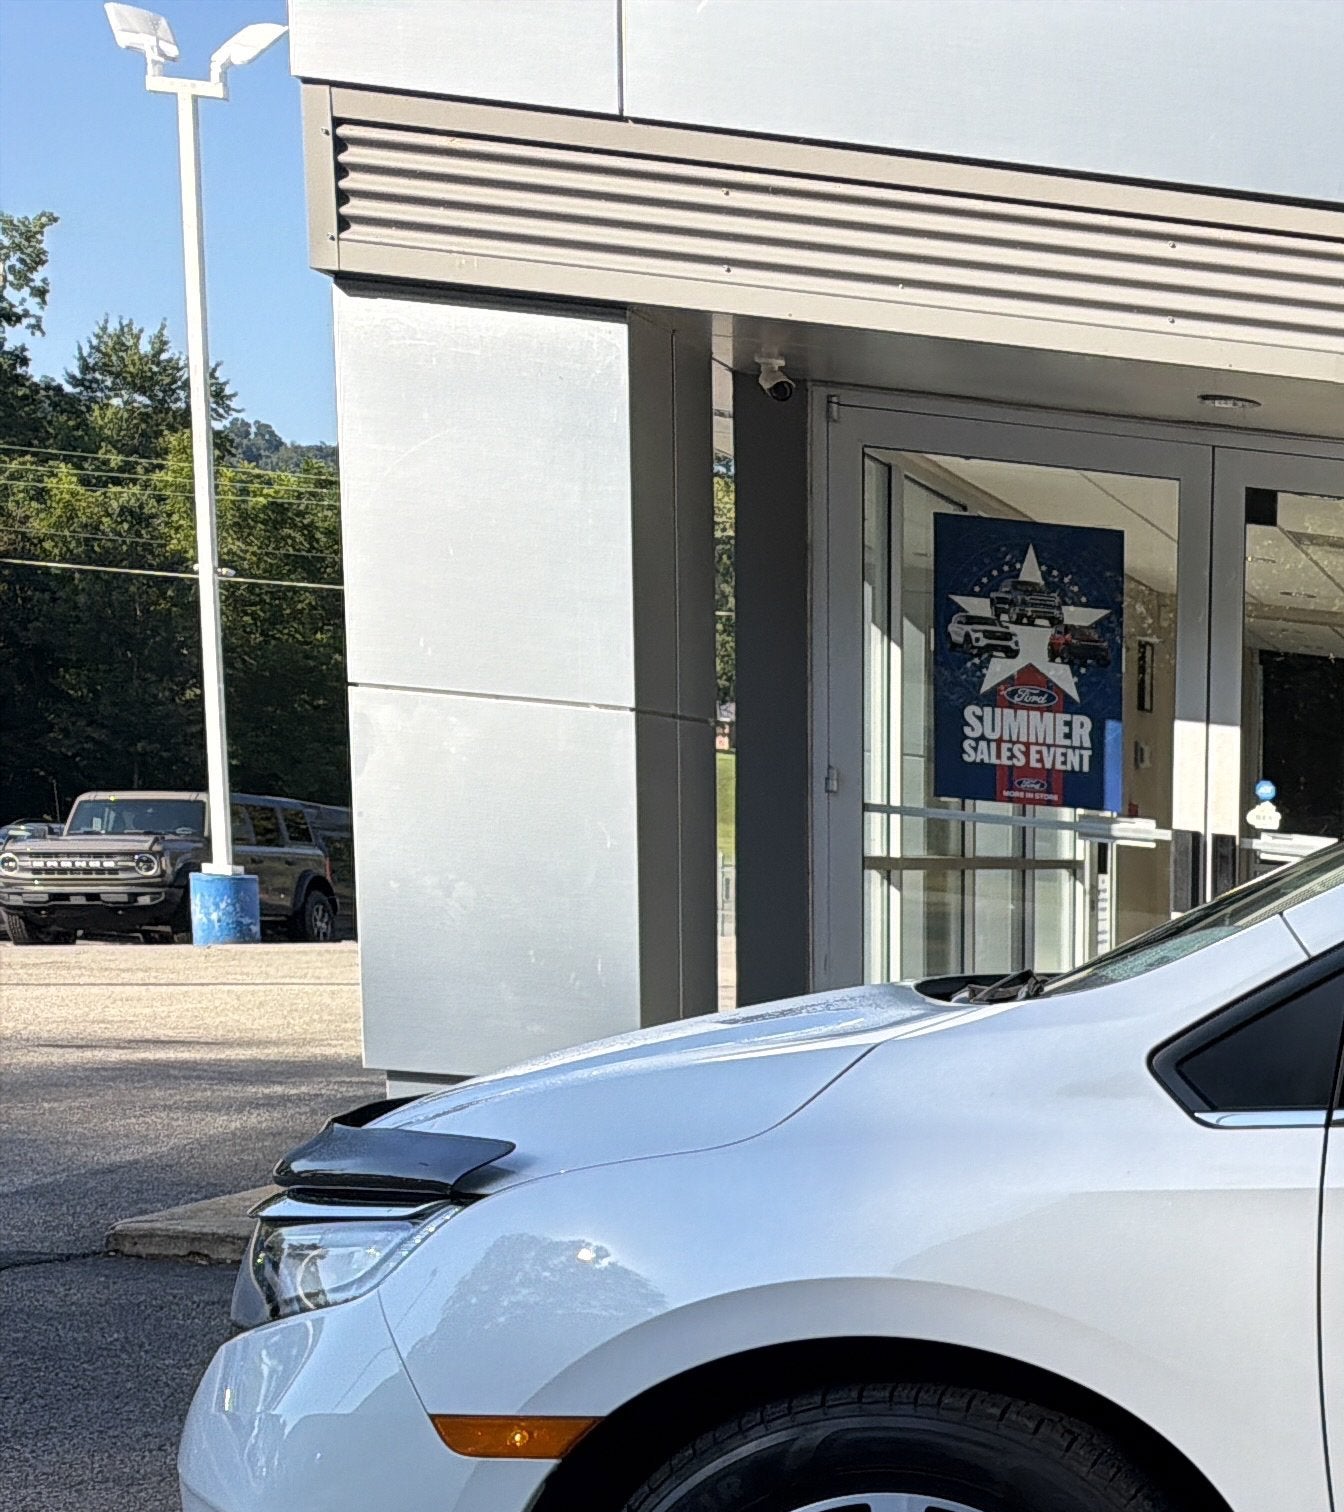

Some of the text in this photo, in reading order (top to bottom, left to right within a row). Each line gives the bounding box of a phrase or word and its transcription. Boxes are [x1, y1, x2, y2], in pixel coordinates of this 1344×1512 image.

[1013, 688, 1049, 704] Ford
[962, 704, 1093, 748] SUMMER
[961, 738, 1093, 773] SALES EVENT
[1002, 790, 1024, 798] MORE
[1034, 791, 1059, 800] STORE
